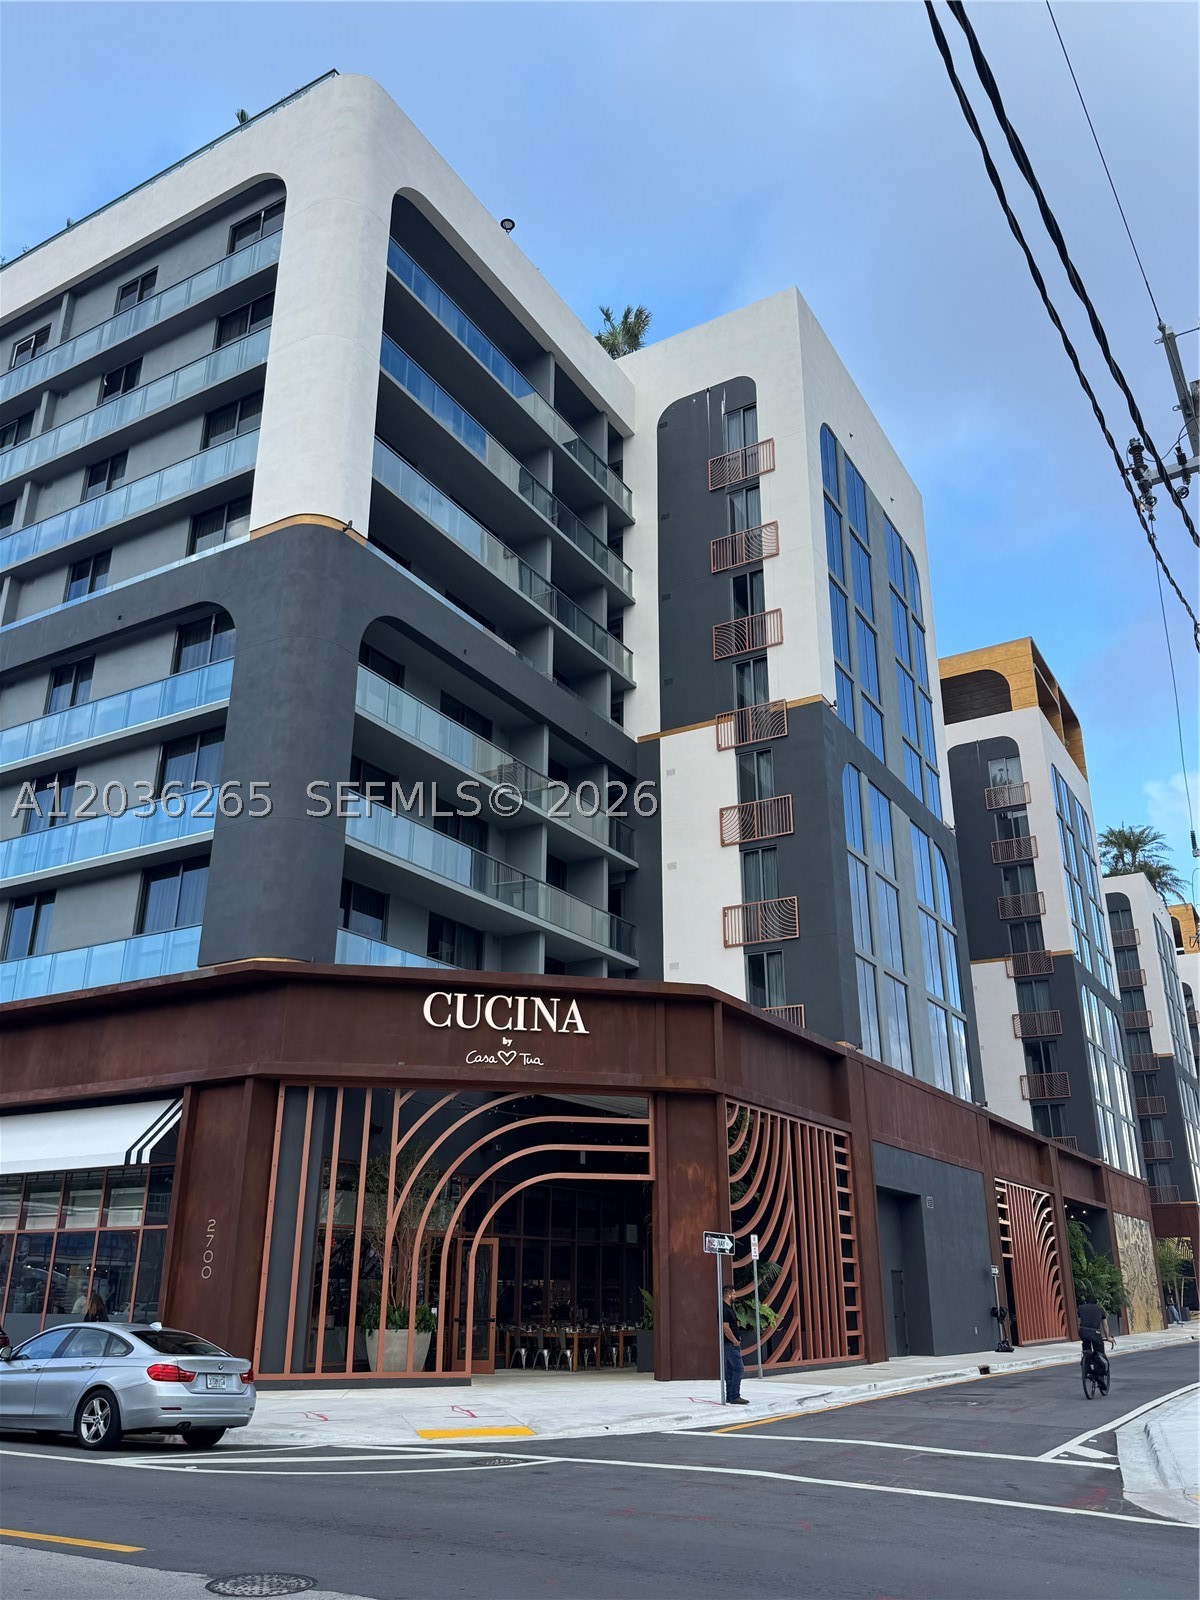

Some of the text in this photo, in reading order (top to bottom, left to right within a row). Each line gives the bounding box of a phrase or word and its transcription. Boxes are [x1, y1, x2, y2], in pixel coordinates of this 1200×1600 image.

[422, 991, 590, 1035] CUCINA
[502, 1036, 513, 1047] by
[465, 1049, 544, 1066] Casa Tua
[201, 1218, 217, 1280] 2700
